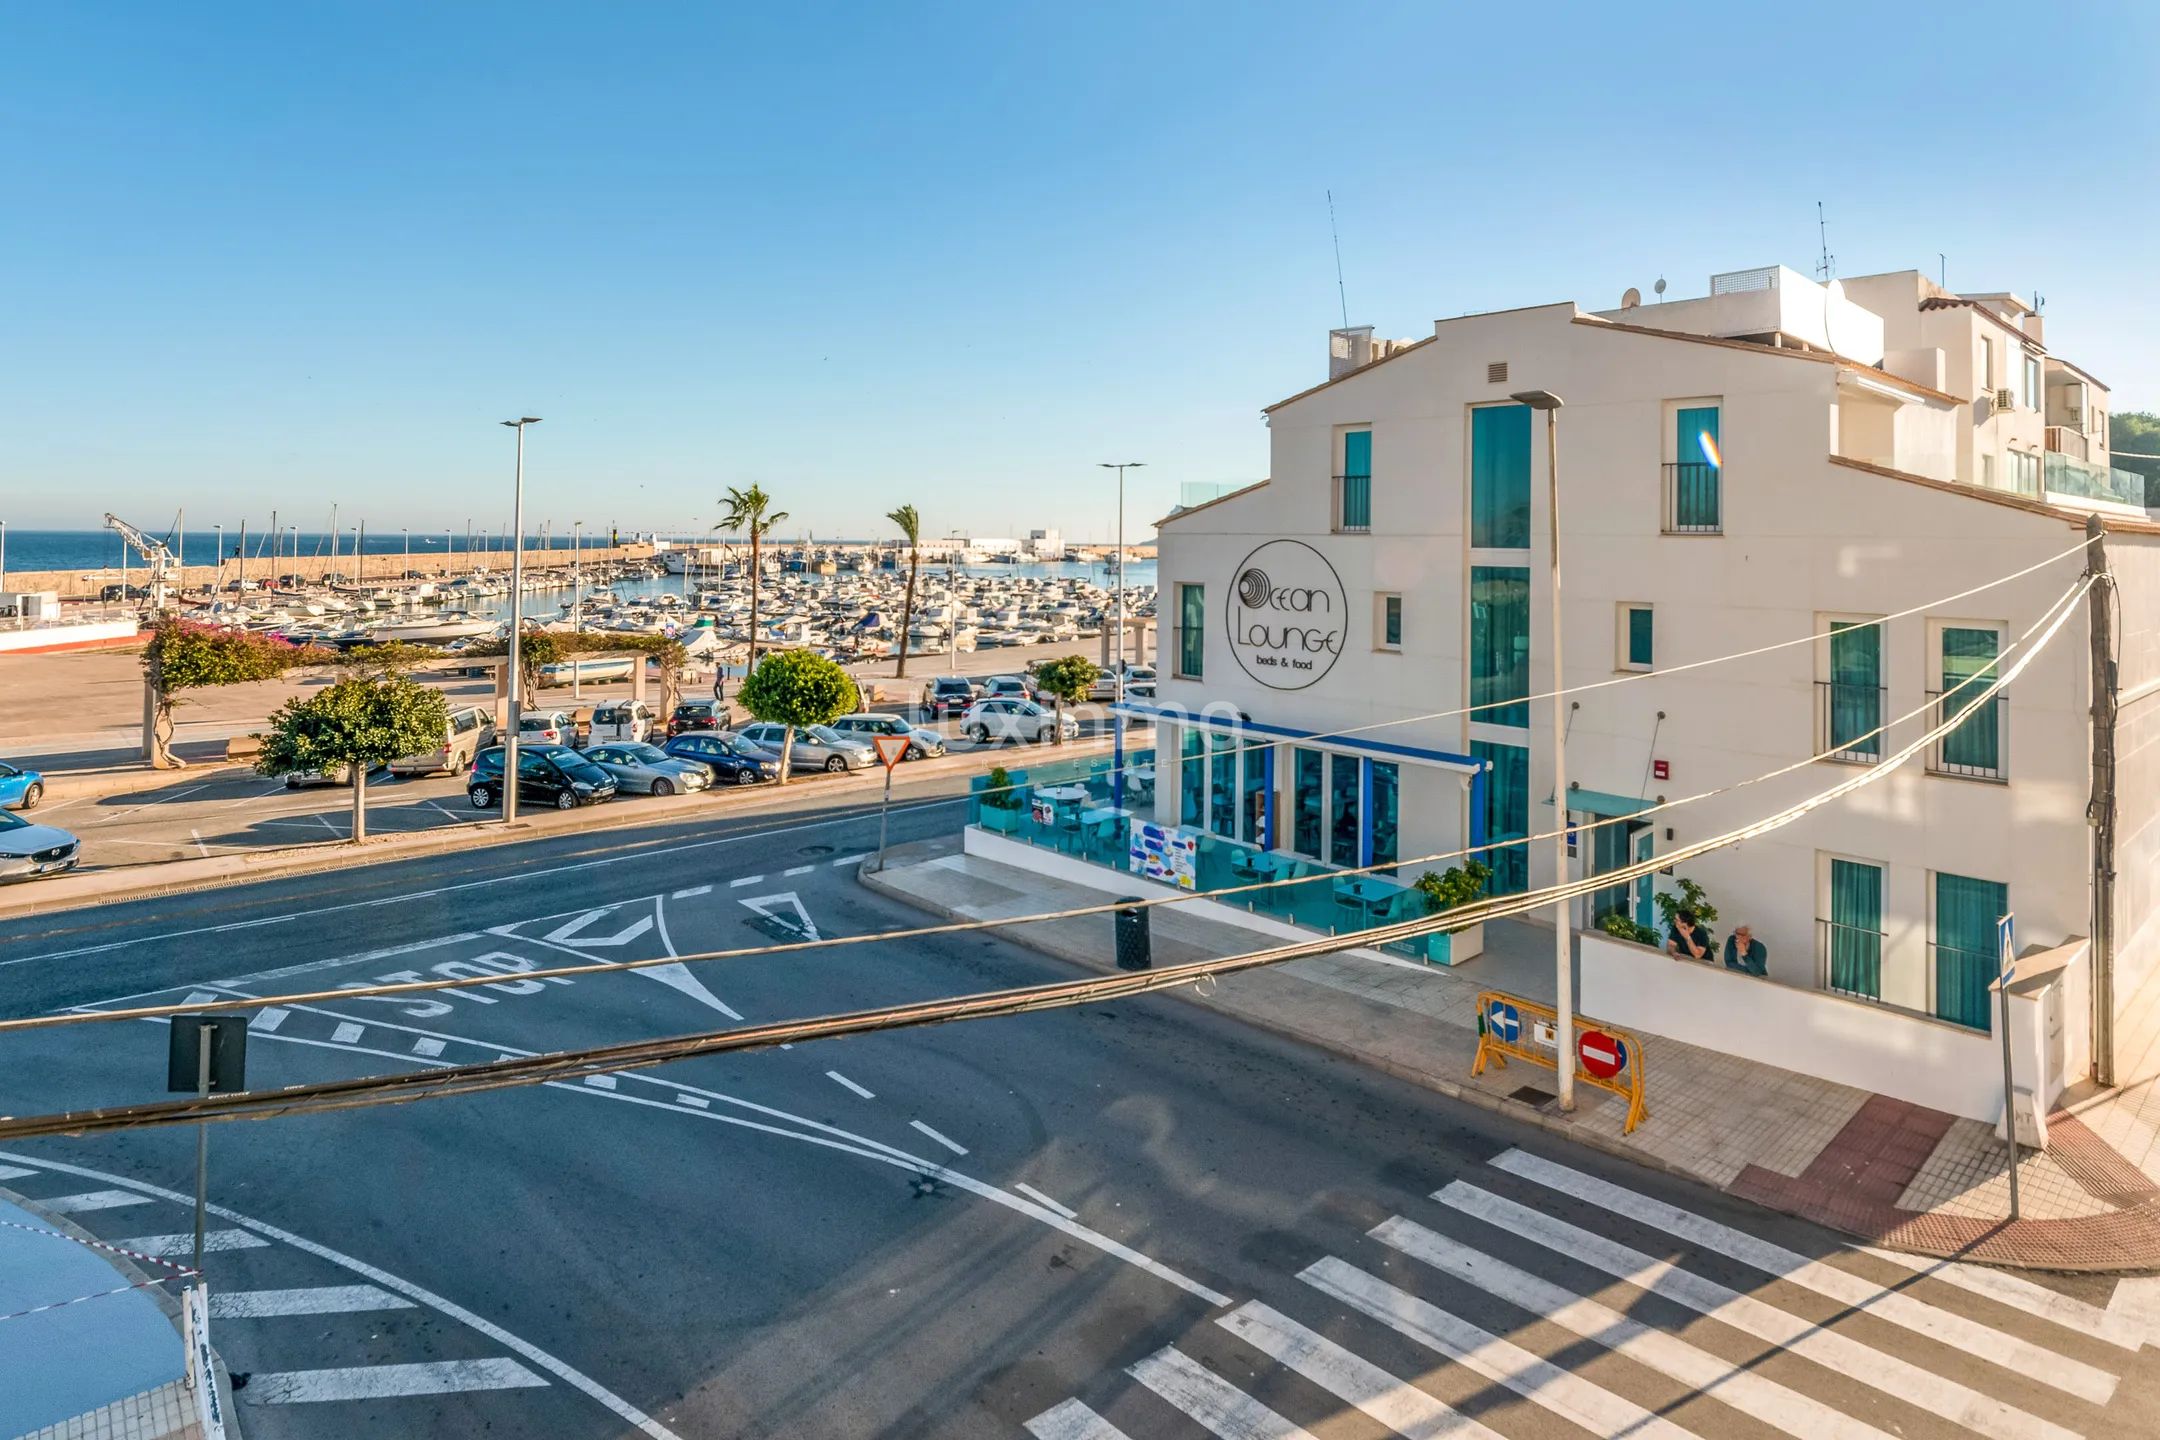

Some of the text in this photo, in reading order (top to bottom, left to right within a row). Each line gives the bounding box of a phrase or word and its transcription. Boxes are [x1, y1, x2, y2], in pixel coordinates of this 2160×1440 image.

[1238, 568, 1329, 612] Ocean
[1237, 606, 1338, 655] Lounge
[1256, 655, 1312, 670] beds & food
[337, 951, 576, 1018] STOP
